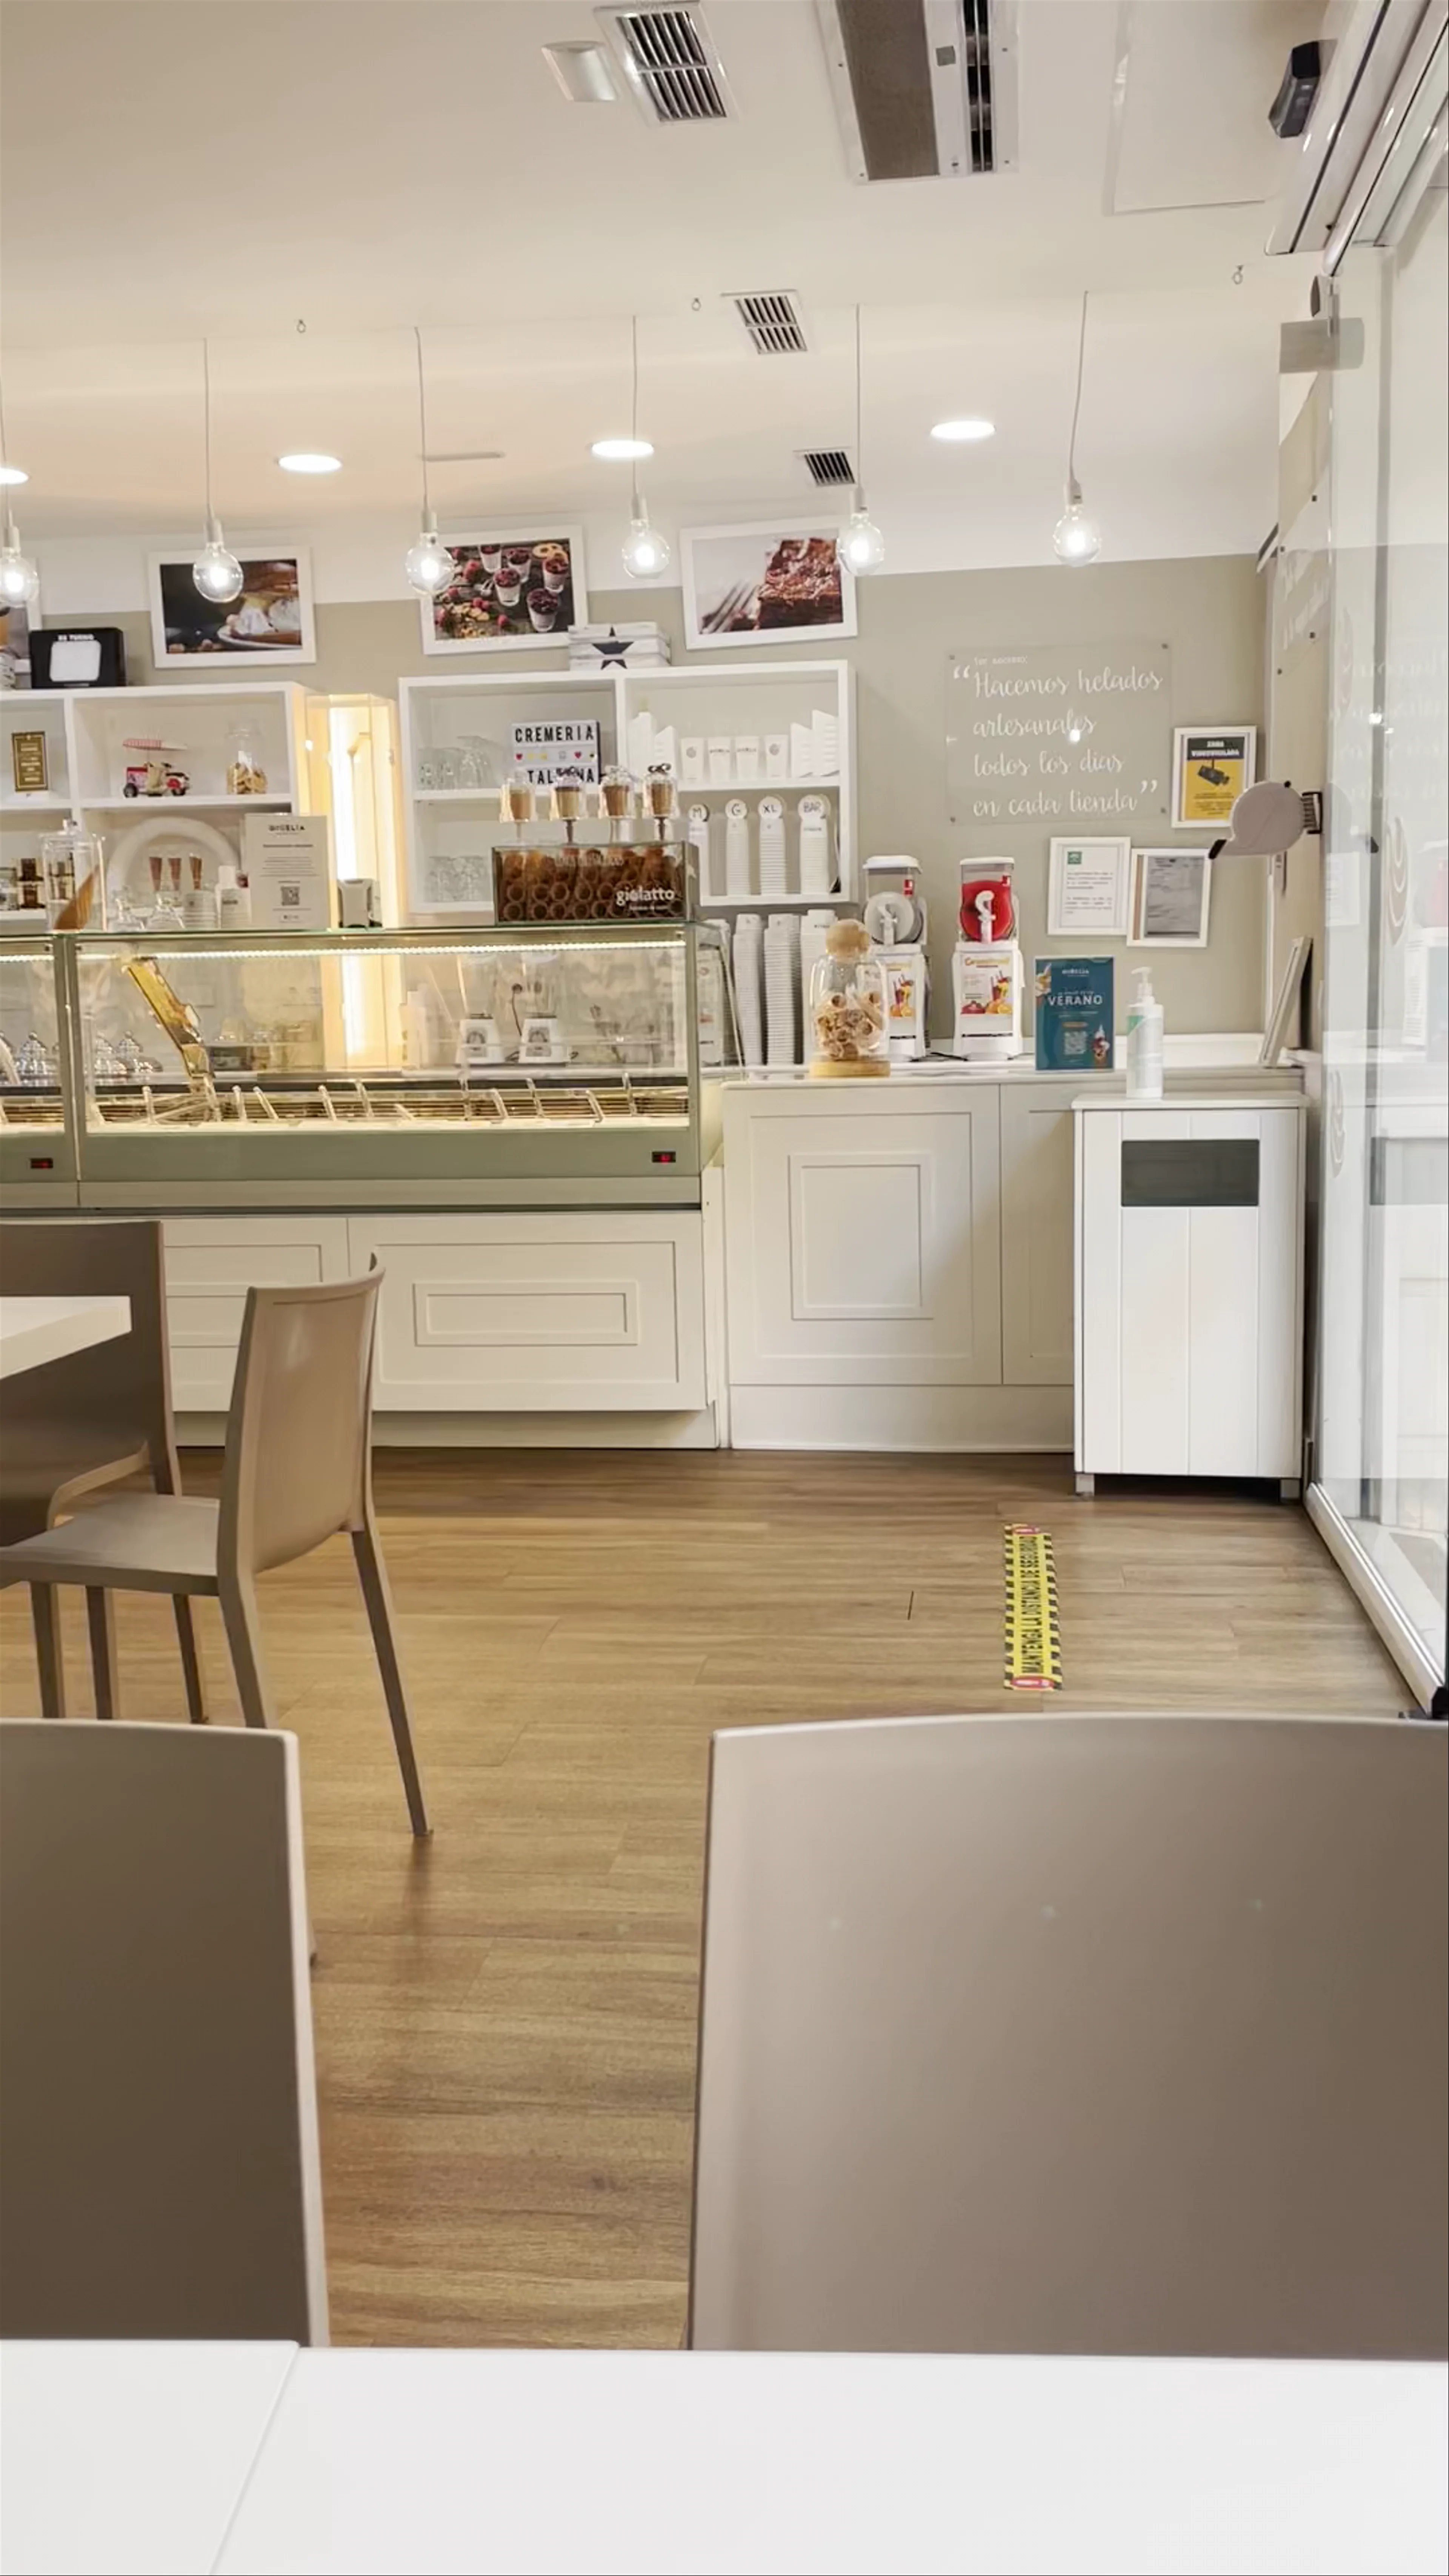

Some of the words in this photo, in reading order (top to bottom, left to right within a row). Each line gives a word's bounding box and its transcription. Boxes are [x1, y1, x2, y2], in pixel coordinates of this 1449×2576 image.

[1078, 666, 1163, 694] helados
[973, 709, 1097, 737] artesanales
[515, 725, 594, 743] CREMERIA
[1040, 751, 1071, 774] los
[692, 807, 702, 818] M
[731, 803, 741, 816] G
[763, 804, 778, 814] XL
[973, 800, 1000, 817] en
[1009, 791, 1061, 816] cada
[616, 885, 675, 906] giolatto
[1047, 994, 1103, 1006] VERANO
